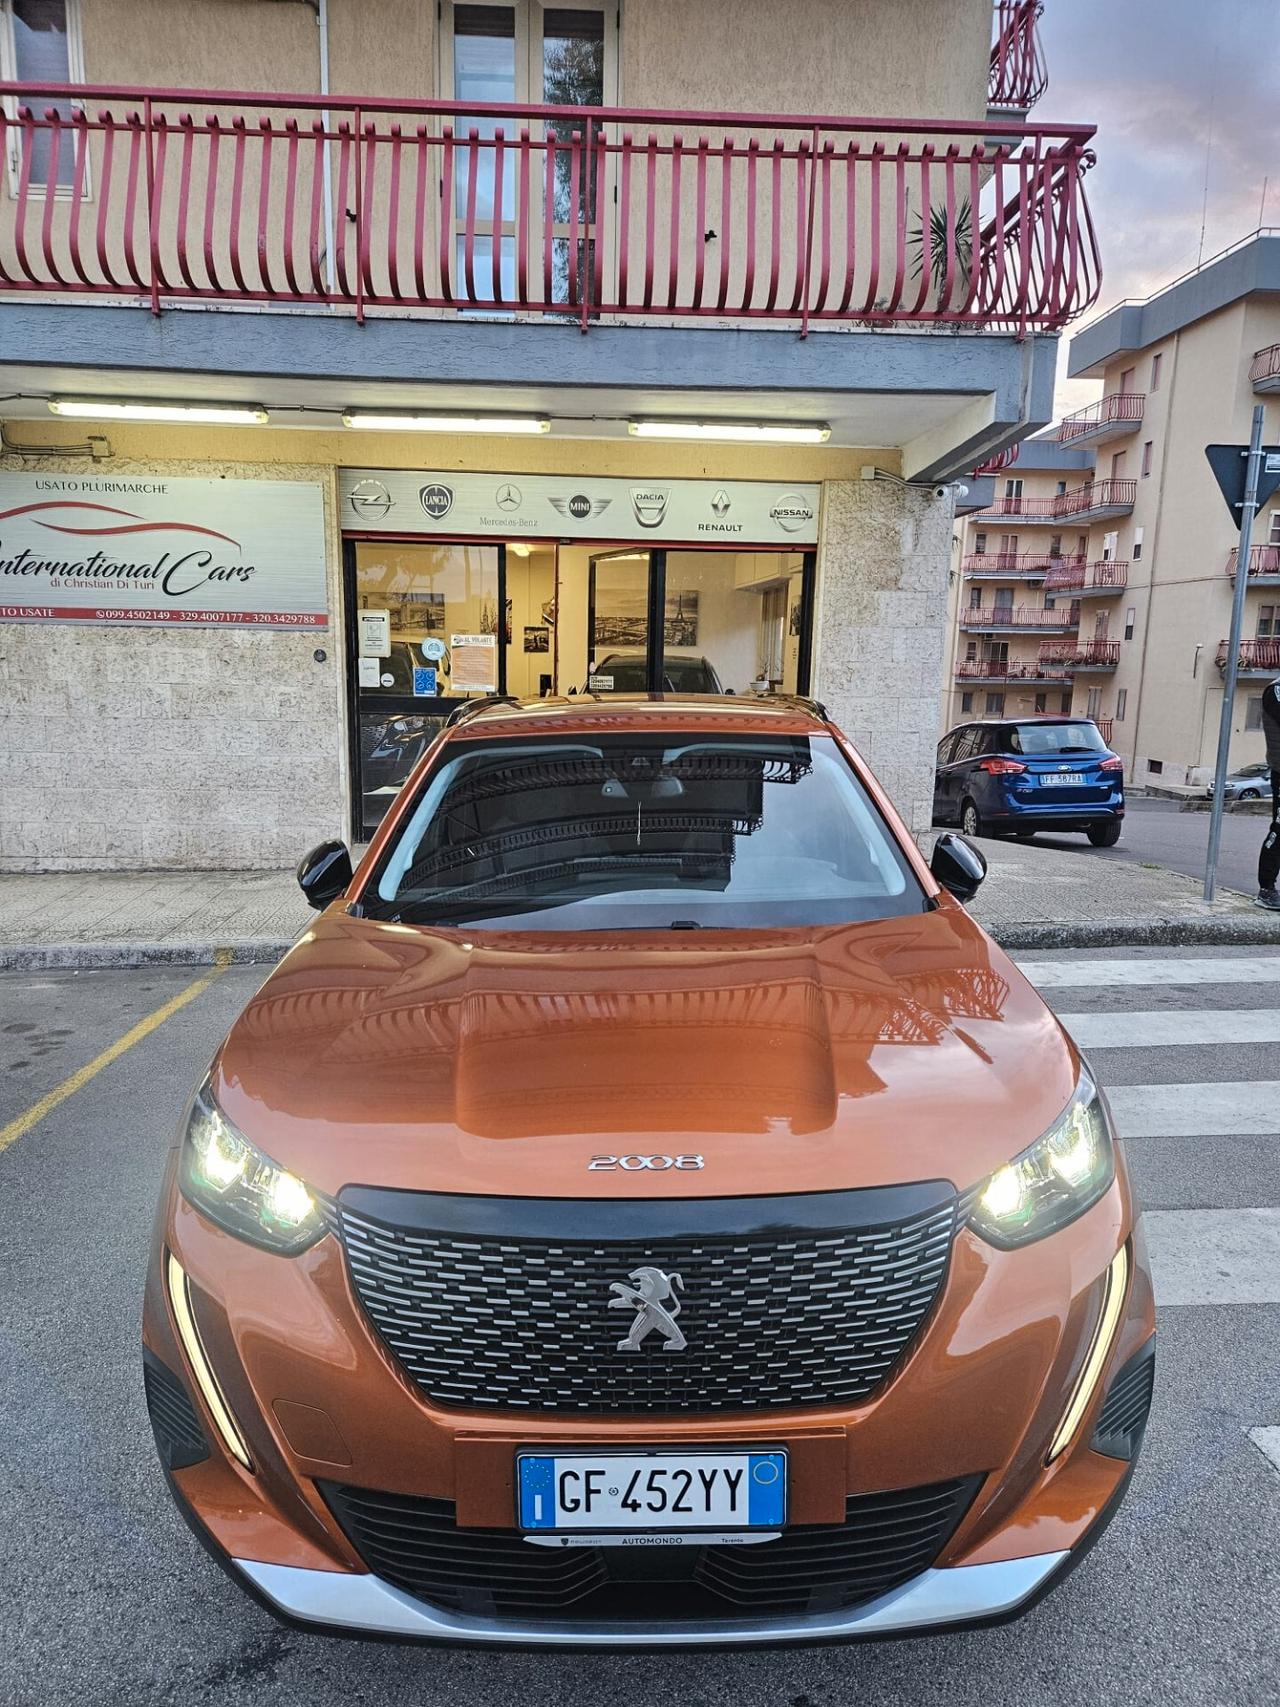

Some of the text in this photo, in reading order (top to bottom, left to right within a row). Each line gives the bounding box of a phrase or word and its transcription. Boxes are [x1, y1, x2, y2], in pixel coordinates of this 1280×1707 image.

[35, 480, 169, 494] USATO PLURIMARCHE
[425, 495, 448, 505] LANCIA
[636, 493, 664, 501] DACIA
[570, 502, 590, 511] MINI
[772, 508, 810, 517] NISSAN
[698, 523, 743, 532] RENAULT
[0, 541, 257, 596] nternational Cars
[50, 577, 155, 590] di Christian Di Turi
[20, 608, 56, 617] USATE
[105, 609, 170, 620] 099.4502149
[180, 611, 243, 622] 329.4007177
[252, 613, 316, 624] 320.3429788
[588, 1154, 705, 1171] 2008
[622, 1536, 683, 1545] AUTOMONDO
